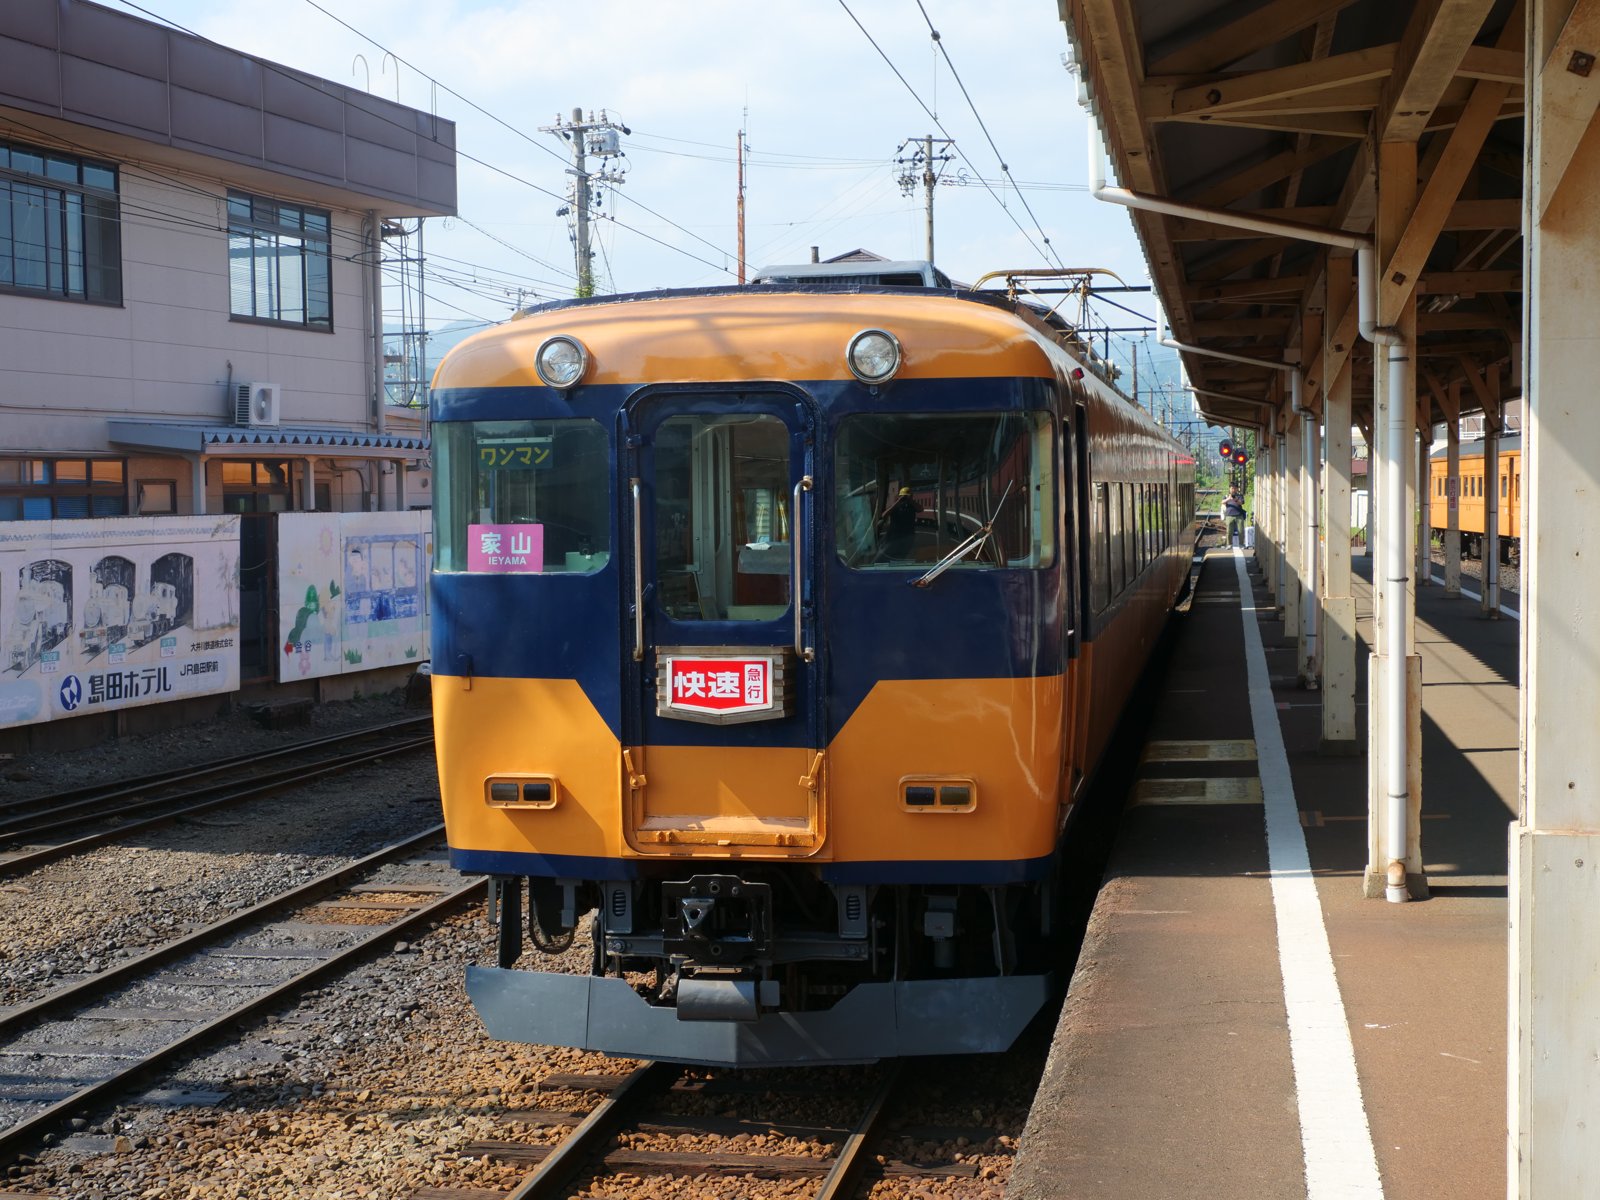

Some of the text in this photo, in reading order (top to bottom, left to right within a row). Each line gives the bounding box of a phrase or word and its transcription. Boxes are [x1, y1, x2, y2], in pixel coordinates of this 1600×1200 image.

[480, 446, 550, 466] ワンマン
[480, 531, 532, 555] 家山
[488, 556, 527, 565] IEYAMA
[295, 640, 312, 653] 金谷
[87, 666, 172, 705] 島田ホテル
[673, 671, 741, 698] 快速
[747, 667, 761, 699] 急行
